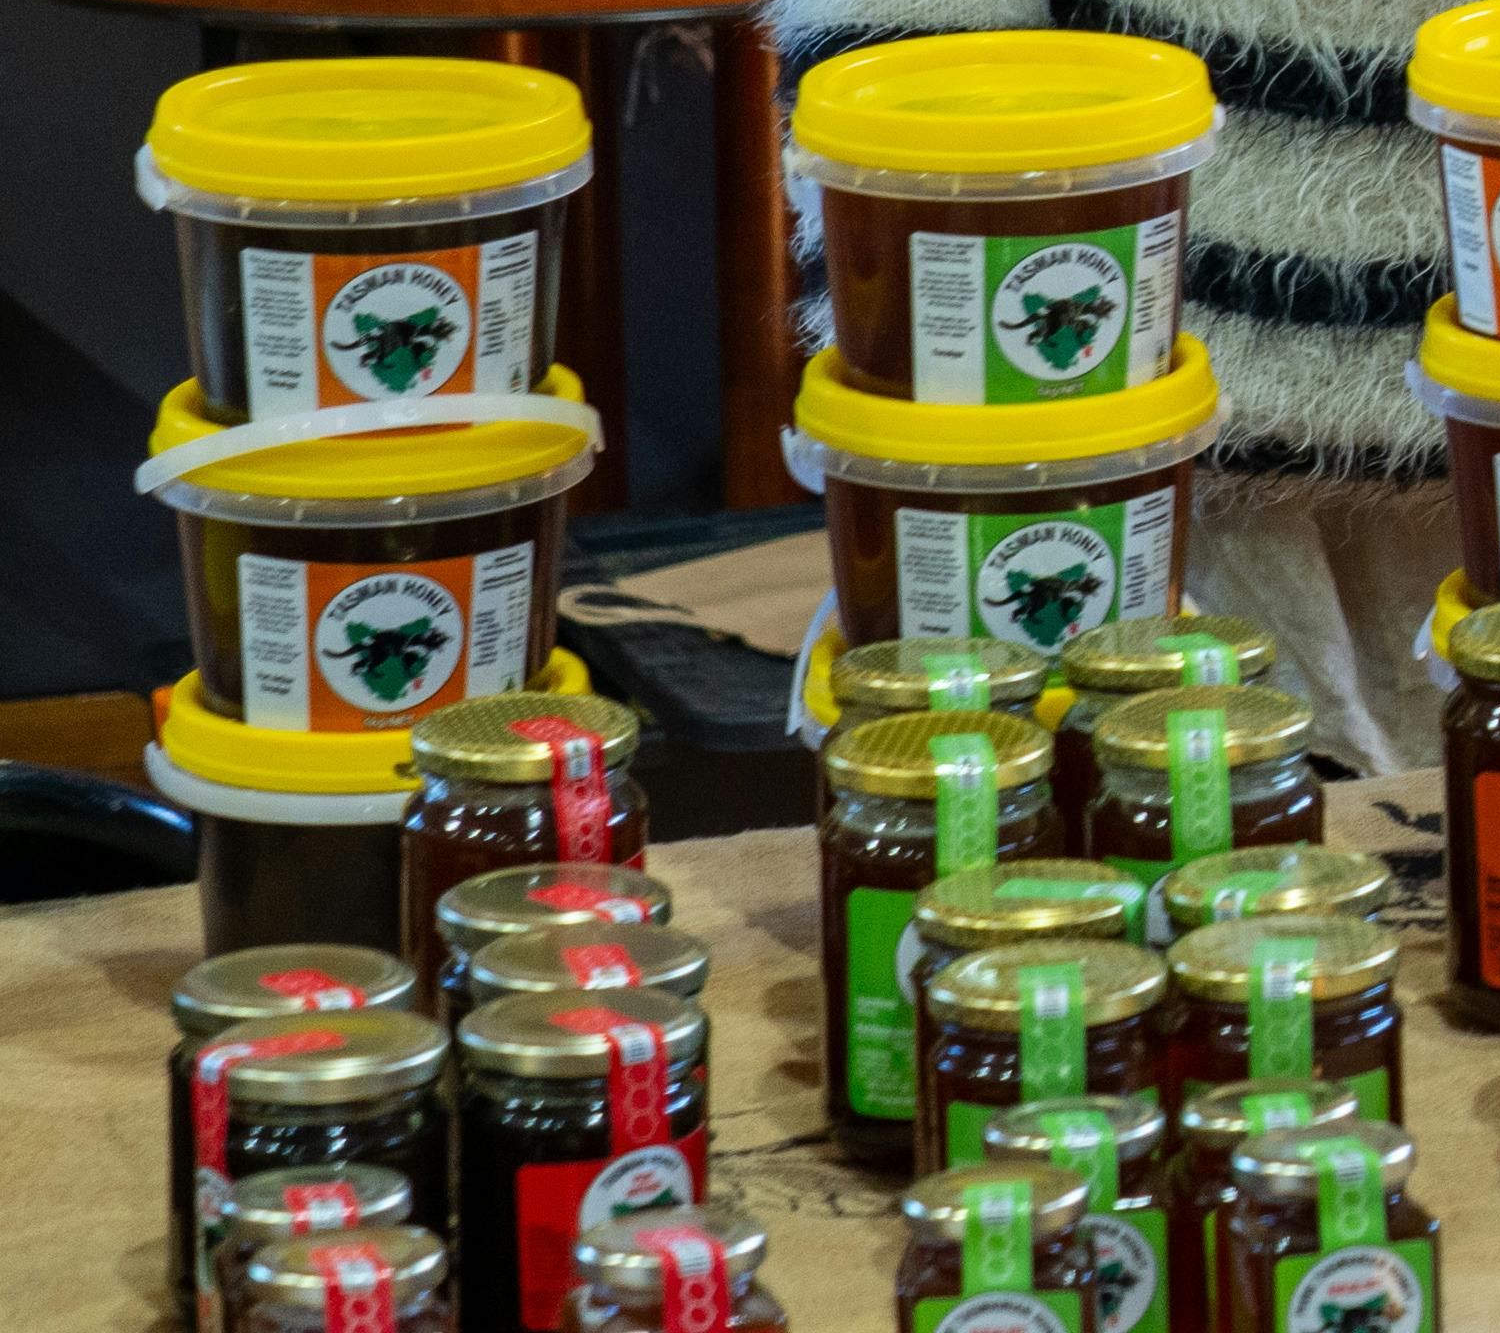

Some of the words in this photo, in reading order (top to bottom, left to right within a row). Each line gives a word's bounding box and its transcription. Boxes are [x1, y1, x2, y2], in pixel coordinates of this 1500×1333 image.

[334, 268, 405, 313] TASMAN
[412, 269, 462, 307] HONEY
[1004, 248, 1072, 293] TASMAN
[1077, 248, 1121, 285] HONEY
[988, 525, 1055, 569] TASMAN
[1060, 525, 1106, 562] HONEY
[327, 578, 398, 621] TASMAN
[402, 579, 453, 618] HONEY
